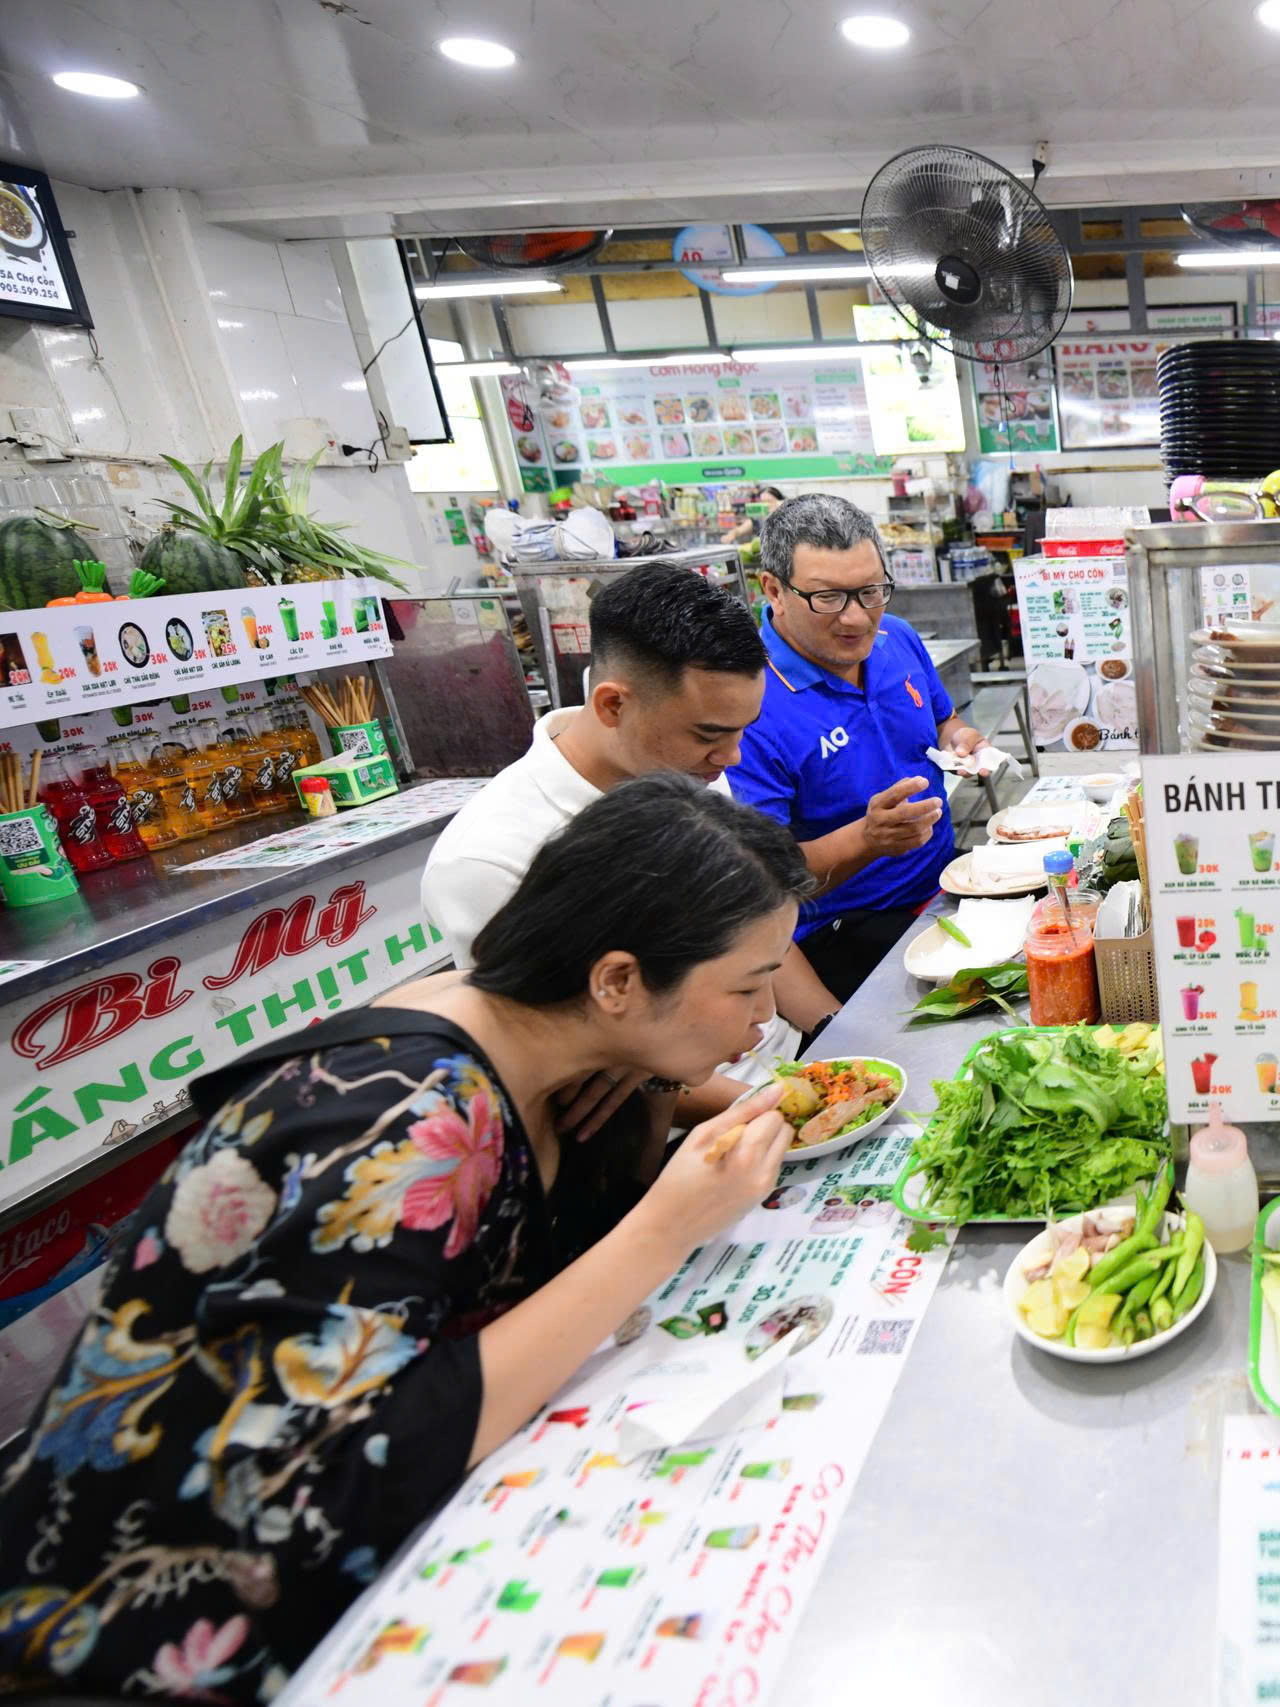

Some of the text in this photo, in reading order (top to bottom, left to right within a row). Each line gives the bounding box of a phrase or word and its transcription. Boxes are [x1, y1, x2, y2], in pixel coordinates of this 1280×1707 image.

[1163, 776, 1245, 813] BÁNH
[202, 880, 378, 989] Mỹ
[0, 1034, 205, 1172] ÁNG
[215, 948, 371, 1049] THỊT
